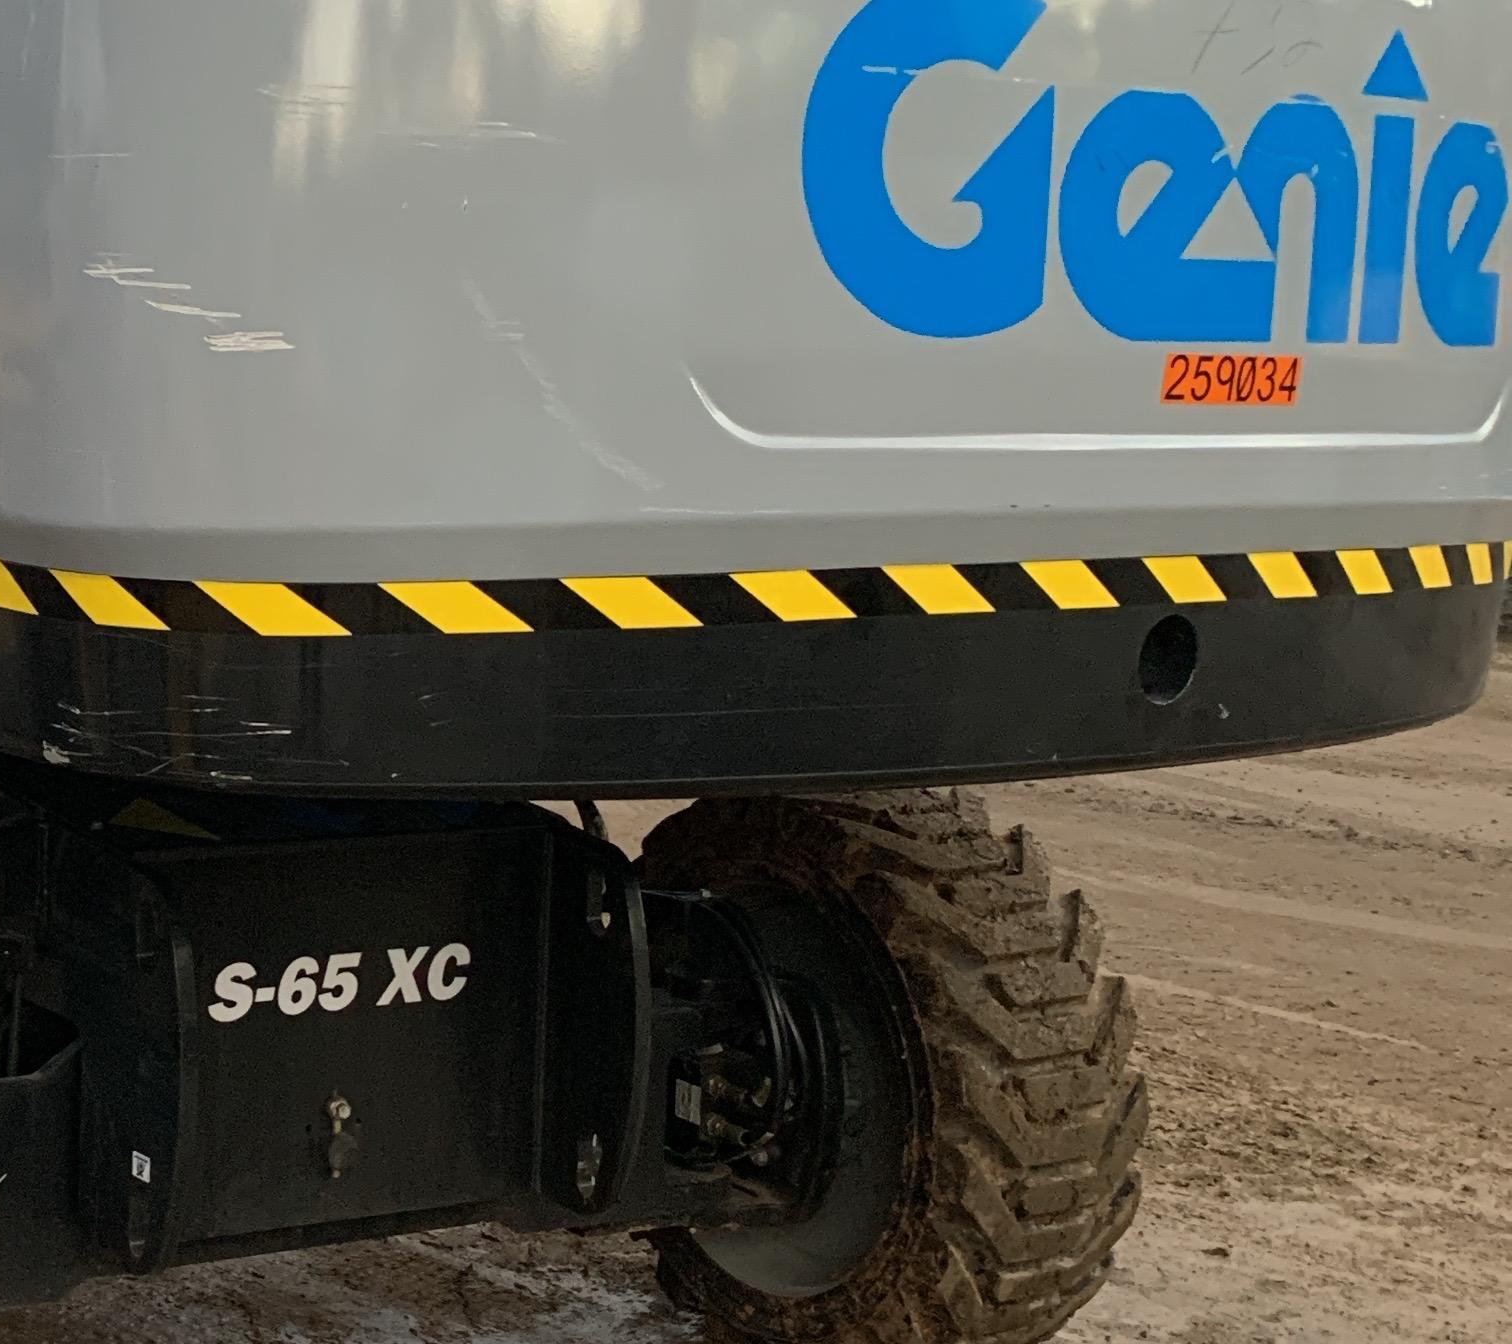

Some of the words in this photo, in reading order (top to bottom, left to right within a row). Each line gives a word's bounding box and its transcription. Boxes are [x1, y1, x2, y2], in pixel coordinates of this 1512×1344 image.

[1163, 354, 1299, 402] 259034
[207, 951, 363, 1023] S-65
[375, 942, 472, 1007] XC
